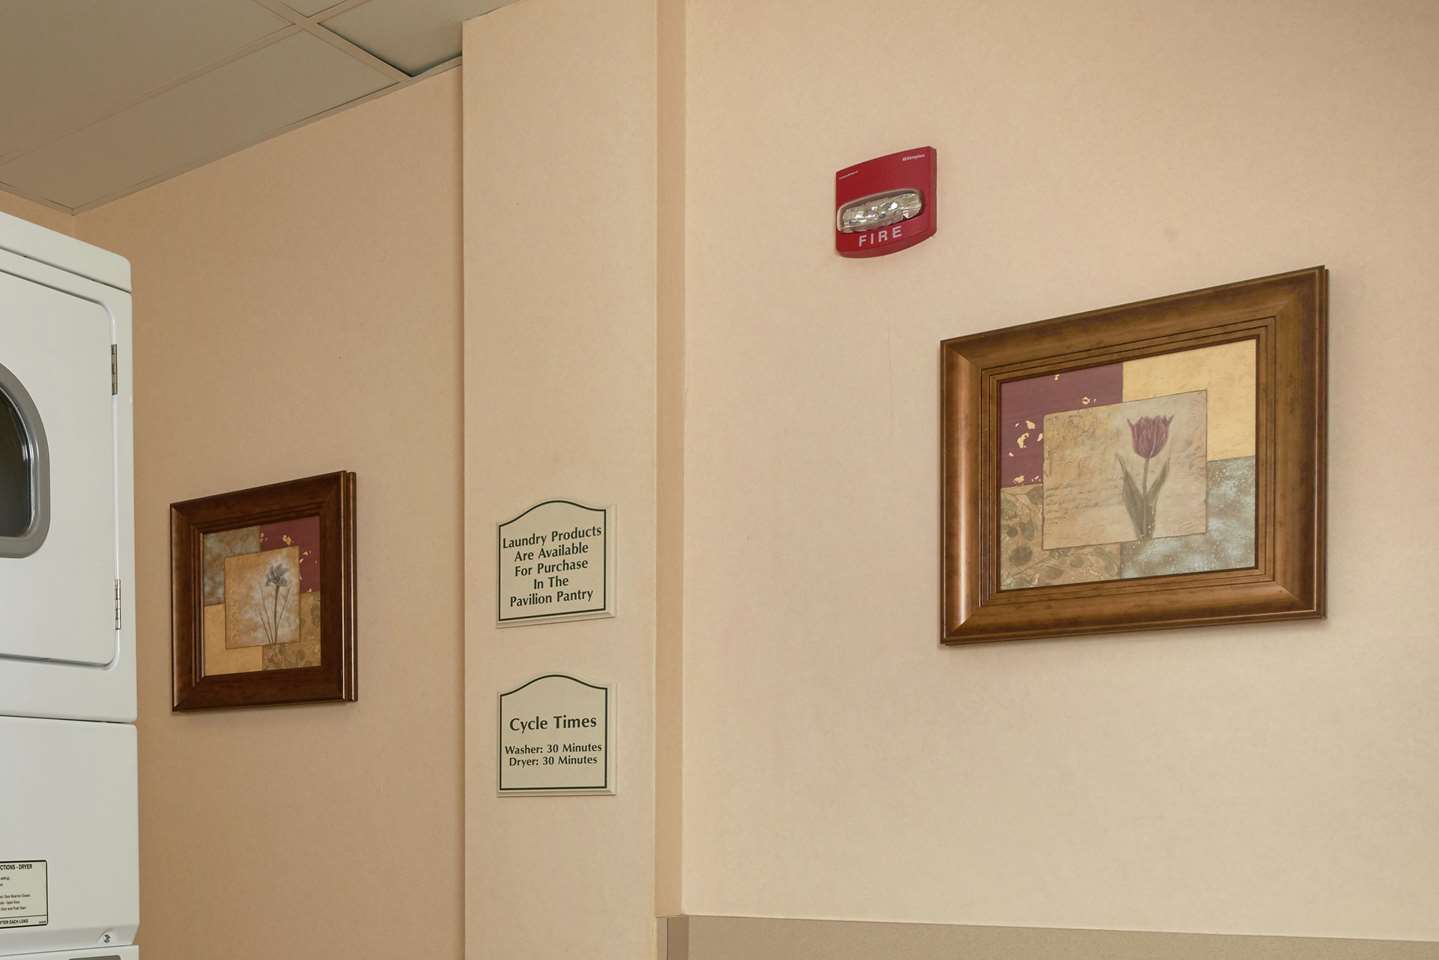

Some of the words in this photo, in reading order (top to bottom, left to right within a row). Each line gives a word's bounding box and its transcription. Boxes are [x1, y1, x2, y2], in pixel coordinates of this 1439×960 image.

[858, 226, 902, 248] FIRE
[503, 533, 547, 549] Laundry
[551, 526, 602, 542] Products
[514, 550, 534, 562] Are
[538, 542, 589, 559] Available
[514, 566, 532, 577] For
[537, 559, 588, 574] Purchase
[533, 579, 544, 590] In
[548, 576, 569, 588] The
[510, 592, 552, 608] Pavilion
[556, 590, 594, 602] Pantry
[509, 716, 548, 734] Cycle
[553, 714, 597, 729] Times
[505, 744, 544, 755] Washer:
[546, 744, 559, 753] 30
[562, 742, 602, 753] Minutes
[509, 757, 539, 768] Dryer:
[542, 756, 554, 766] 30
[558, 755, 598, 765] Minutes
